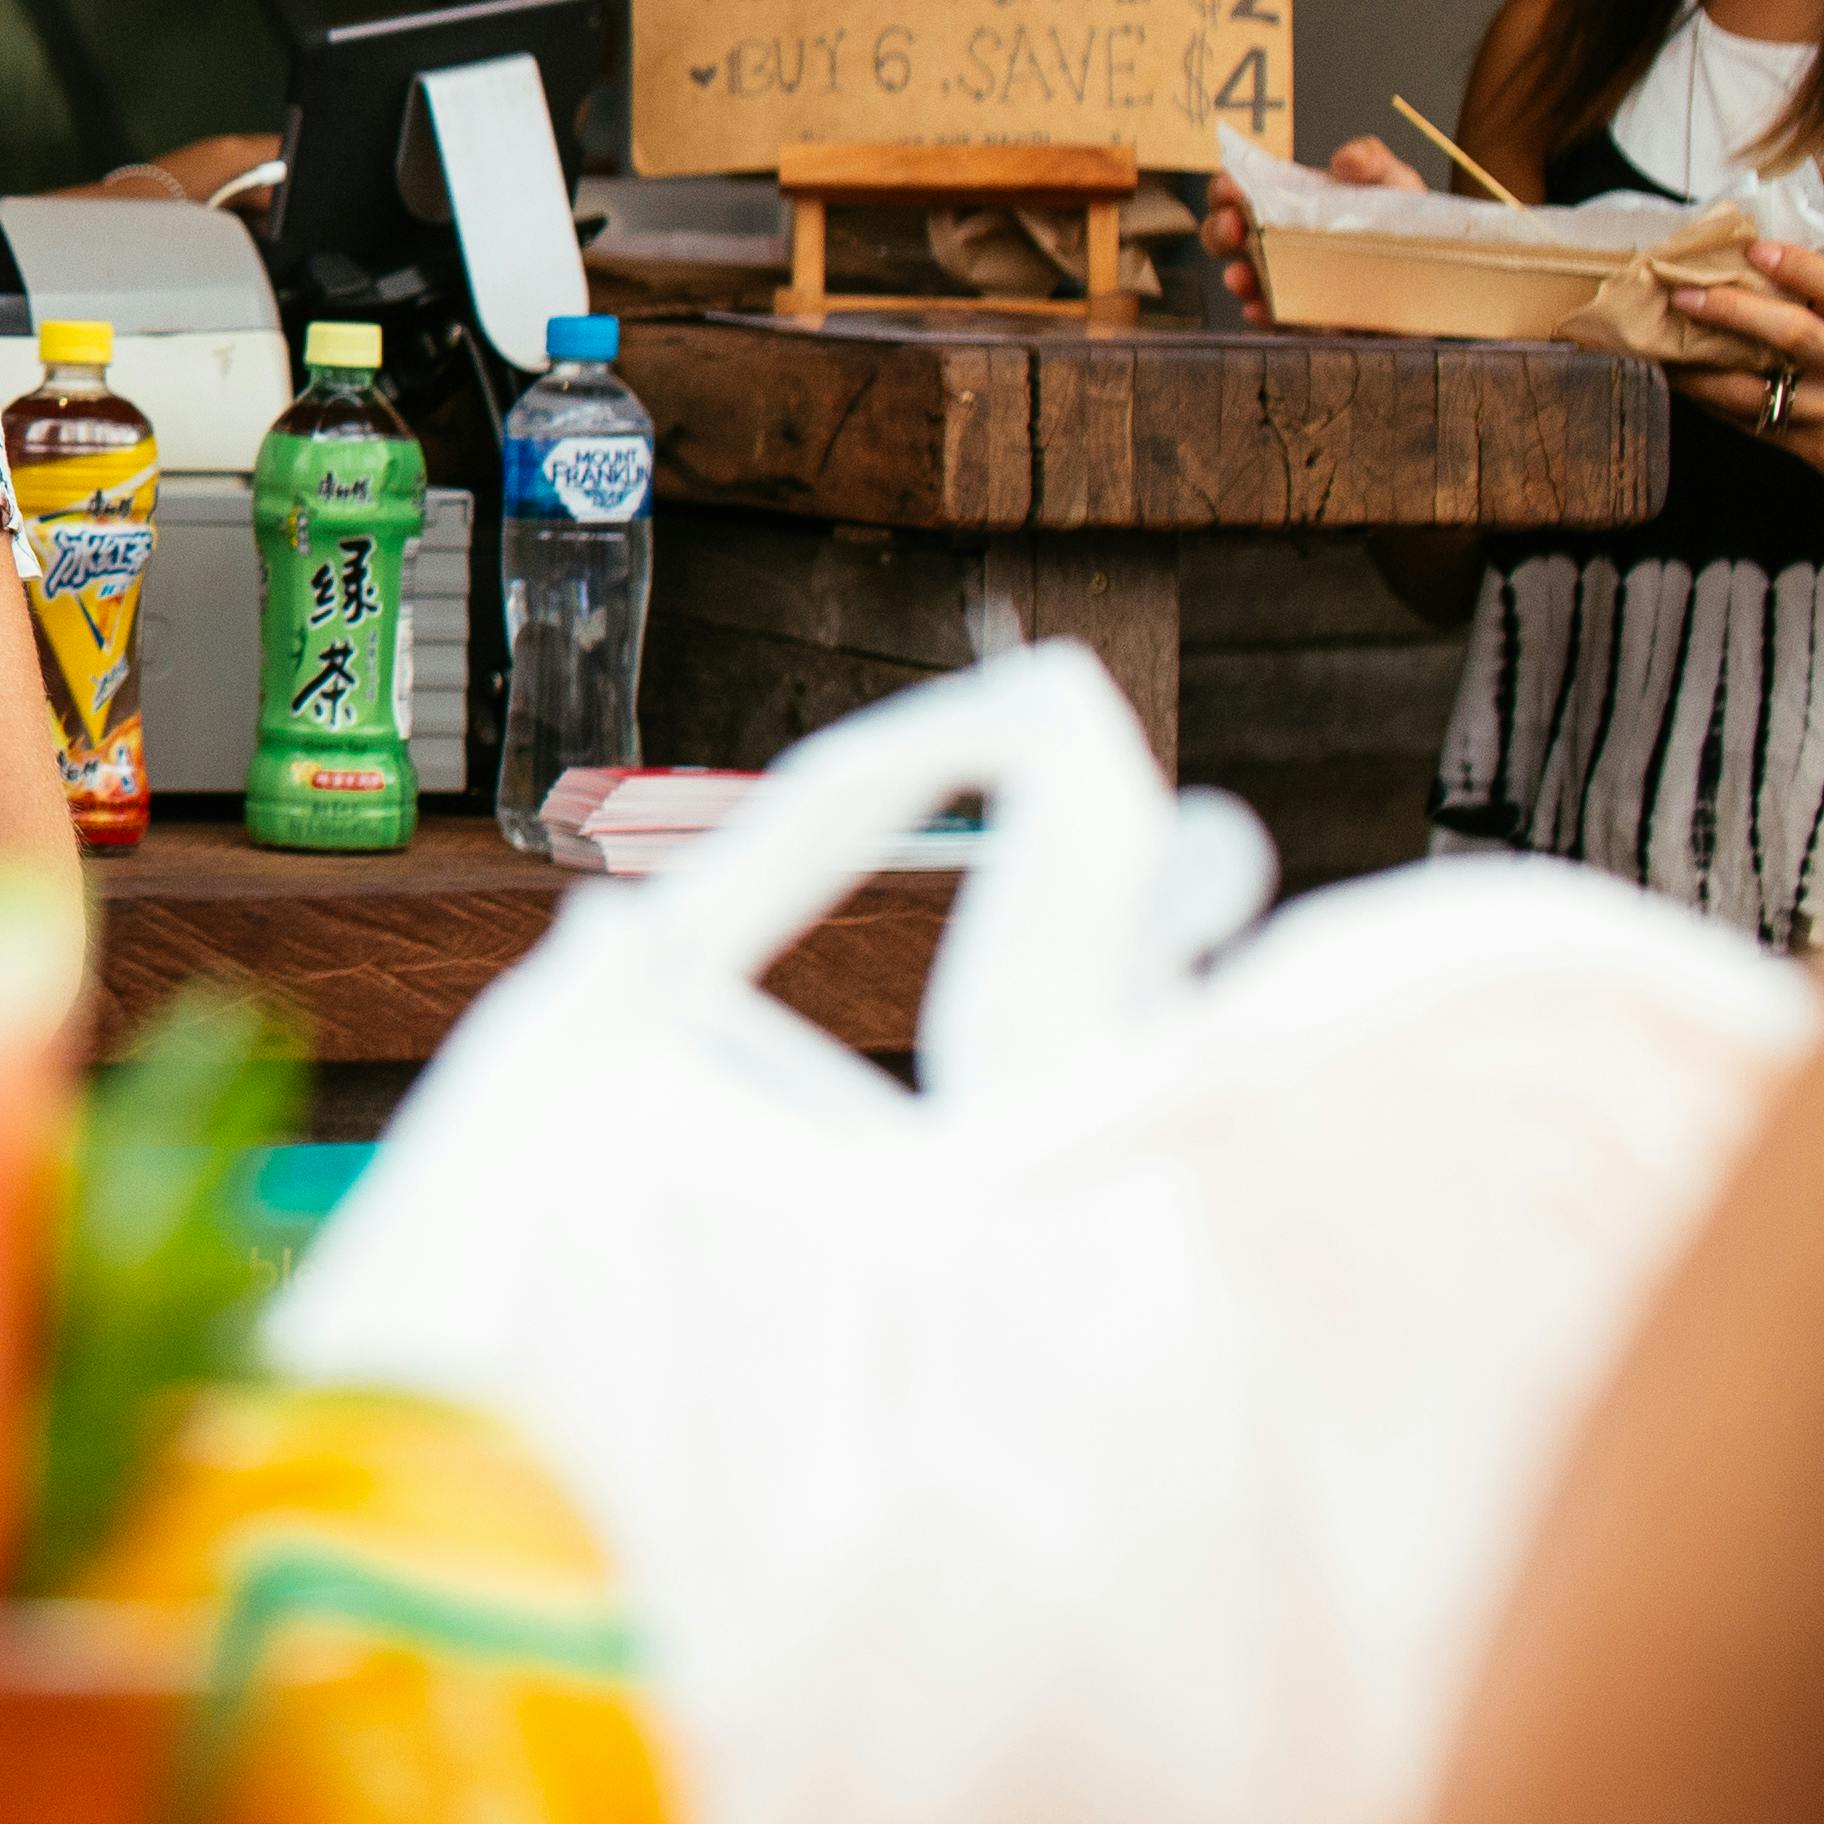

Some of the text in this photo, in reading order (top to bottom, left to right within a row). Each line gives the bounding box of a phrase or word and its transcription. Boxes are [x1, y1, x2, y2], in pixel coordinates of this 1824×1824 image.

[725, 27, 848, 97] BUY
[576, 448, 639, 464] MOUNT
[291, 537, 379, 727] 绿茶
